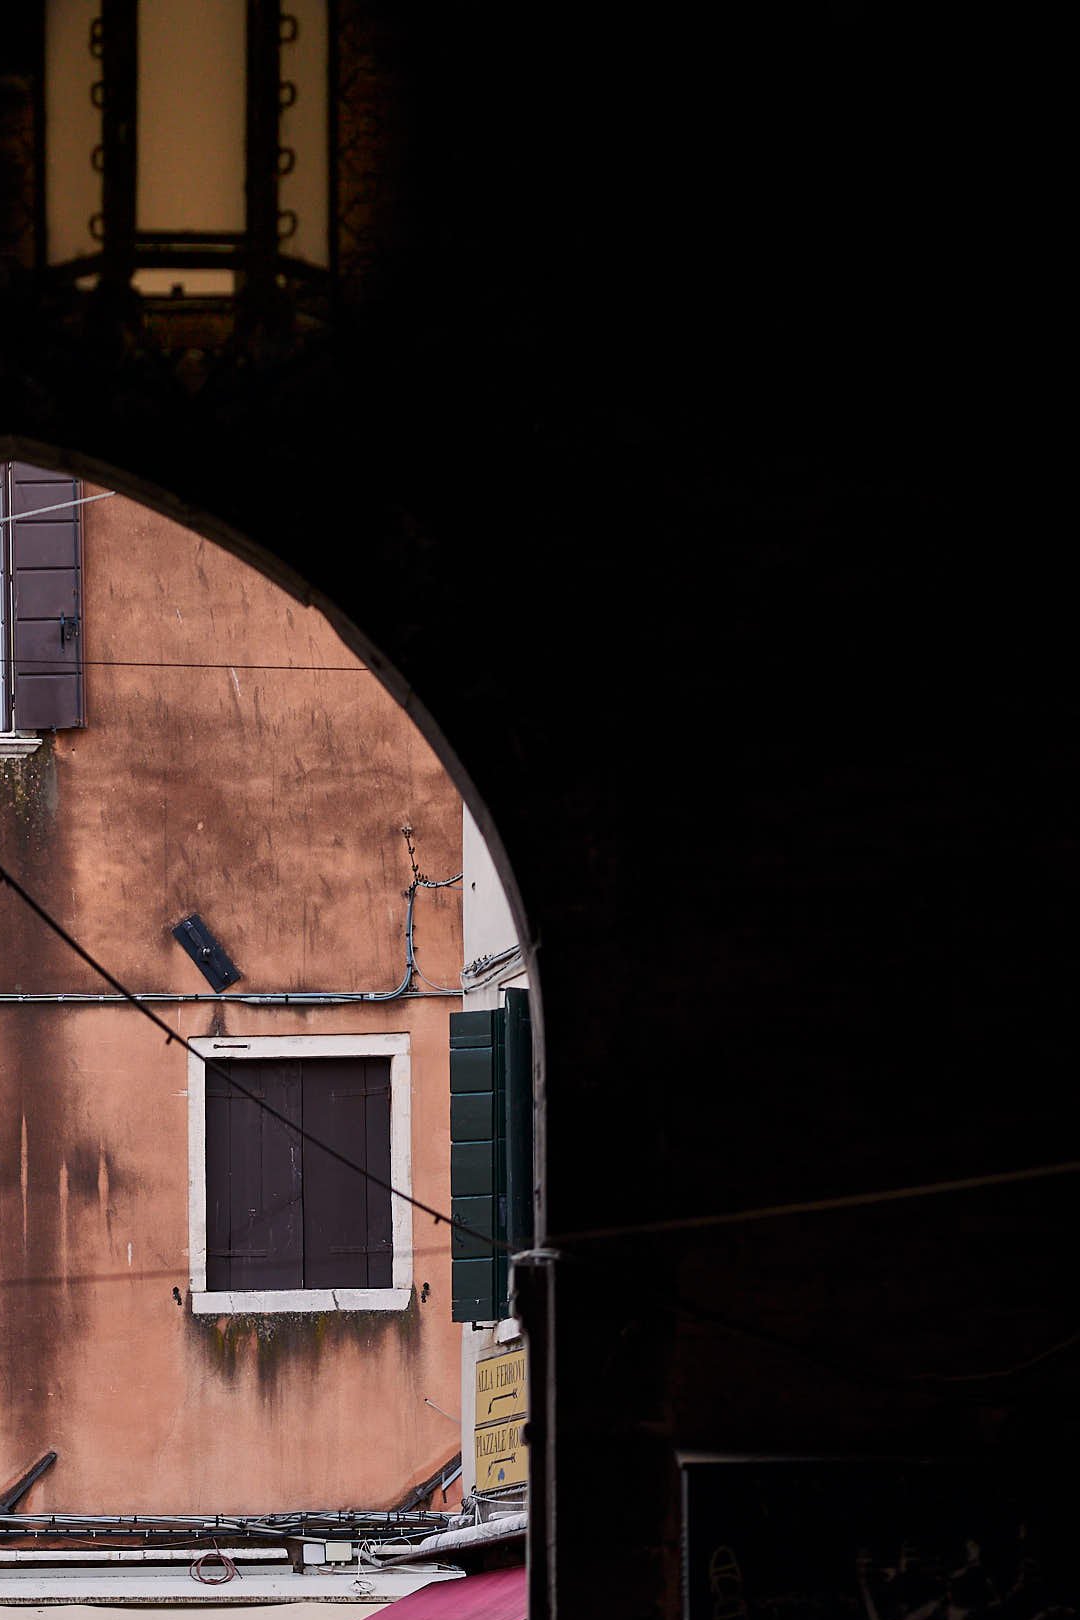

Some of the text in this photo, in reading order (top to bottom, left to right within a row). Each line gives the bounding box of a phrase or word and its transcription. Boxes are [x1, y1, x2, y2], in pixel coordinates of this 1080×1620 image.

[477, 1359, 526, 1393] ALLA FERROVI
[476, 1429, 506, 1458] PIAZZALE
